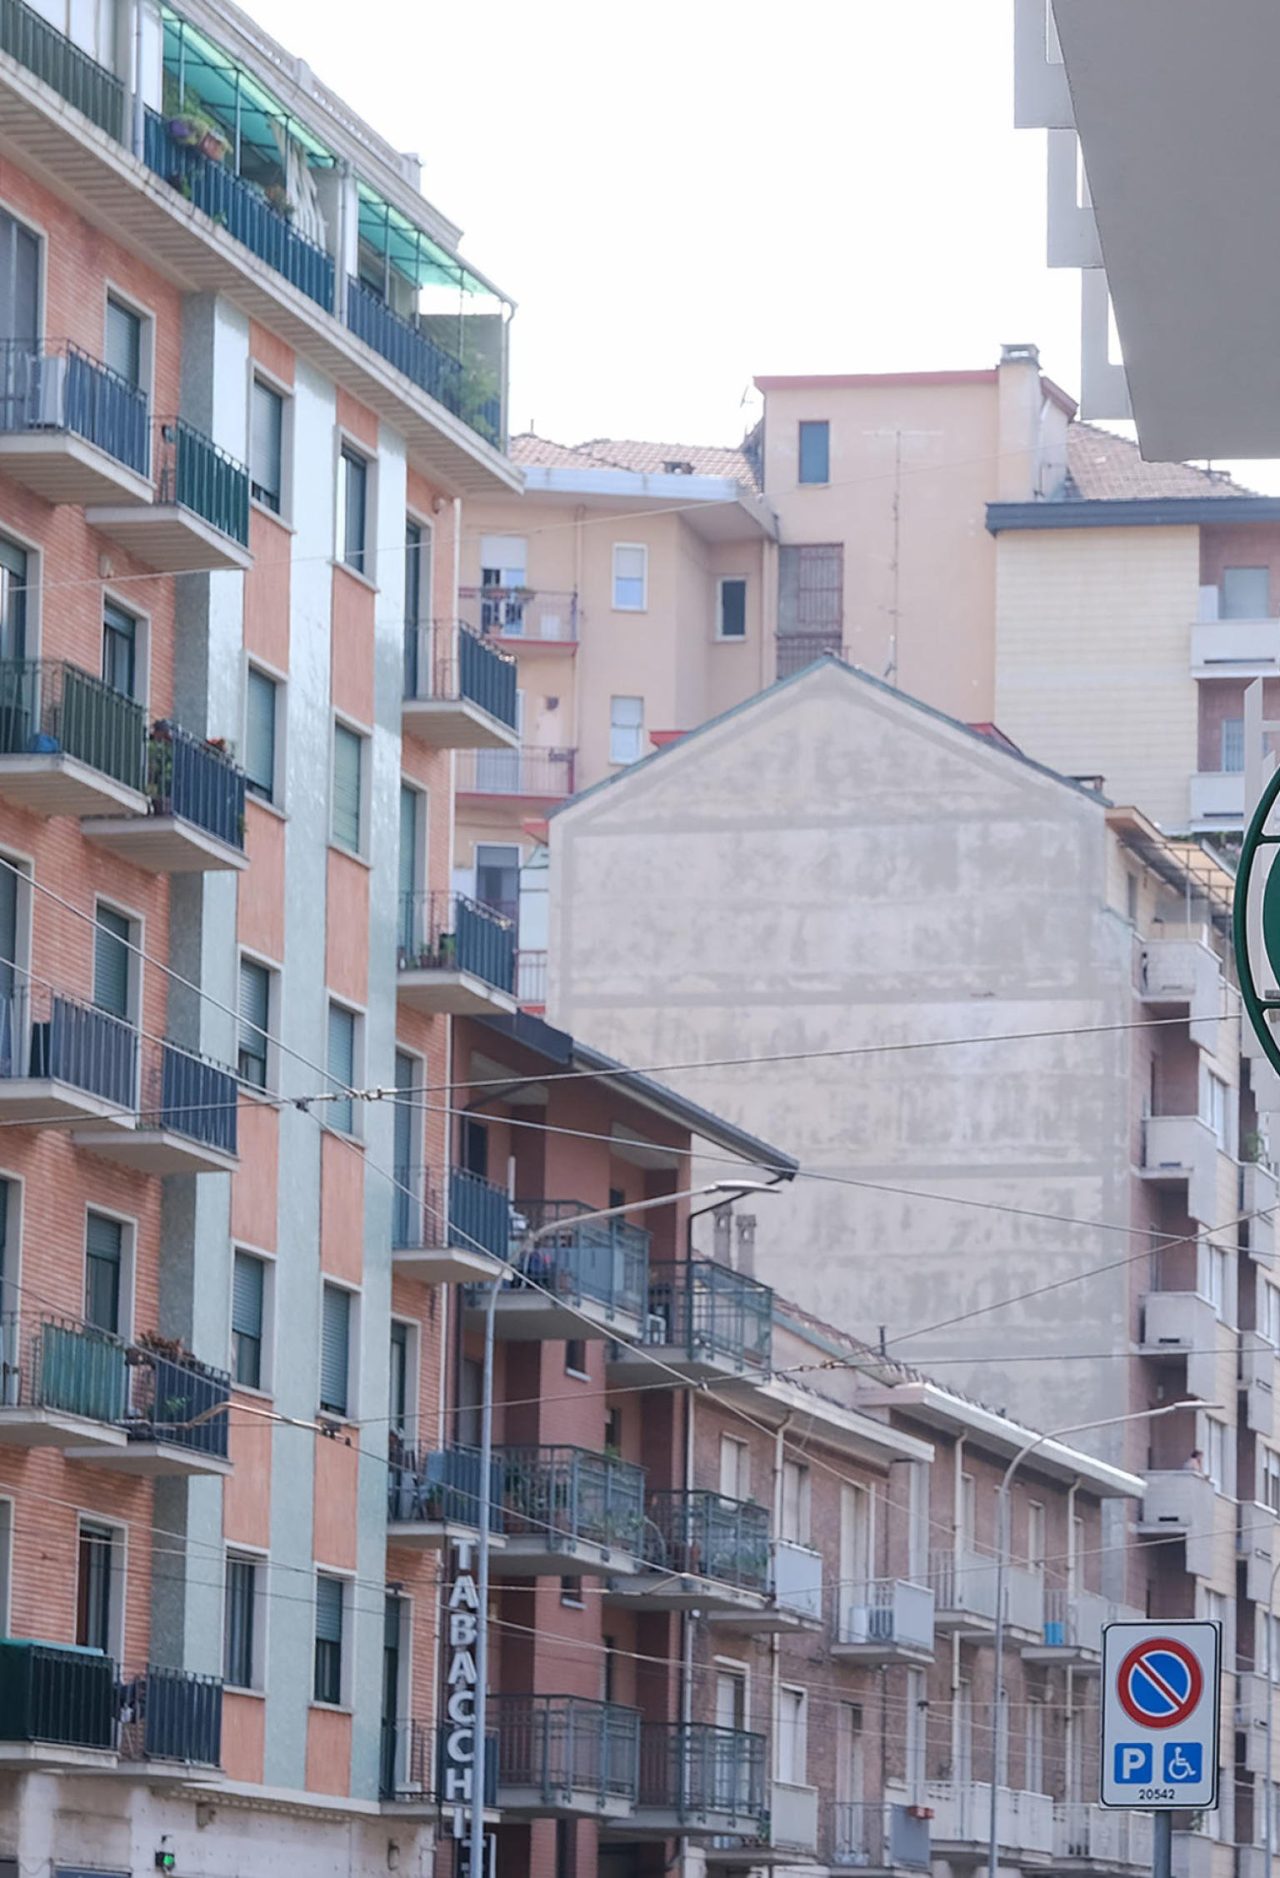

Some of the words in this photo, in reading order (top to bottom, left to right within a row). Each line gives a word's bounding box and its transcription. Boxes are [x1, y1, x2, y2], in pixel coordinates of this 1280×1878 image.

[446, 1538, 479, 1838] TABACCHI
[1122, 1747, 1146, 1780] P
[1138, 1788, 1176, 1800] 20542
